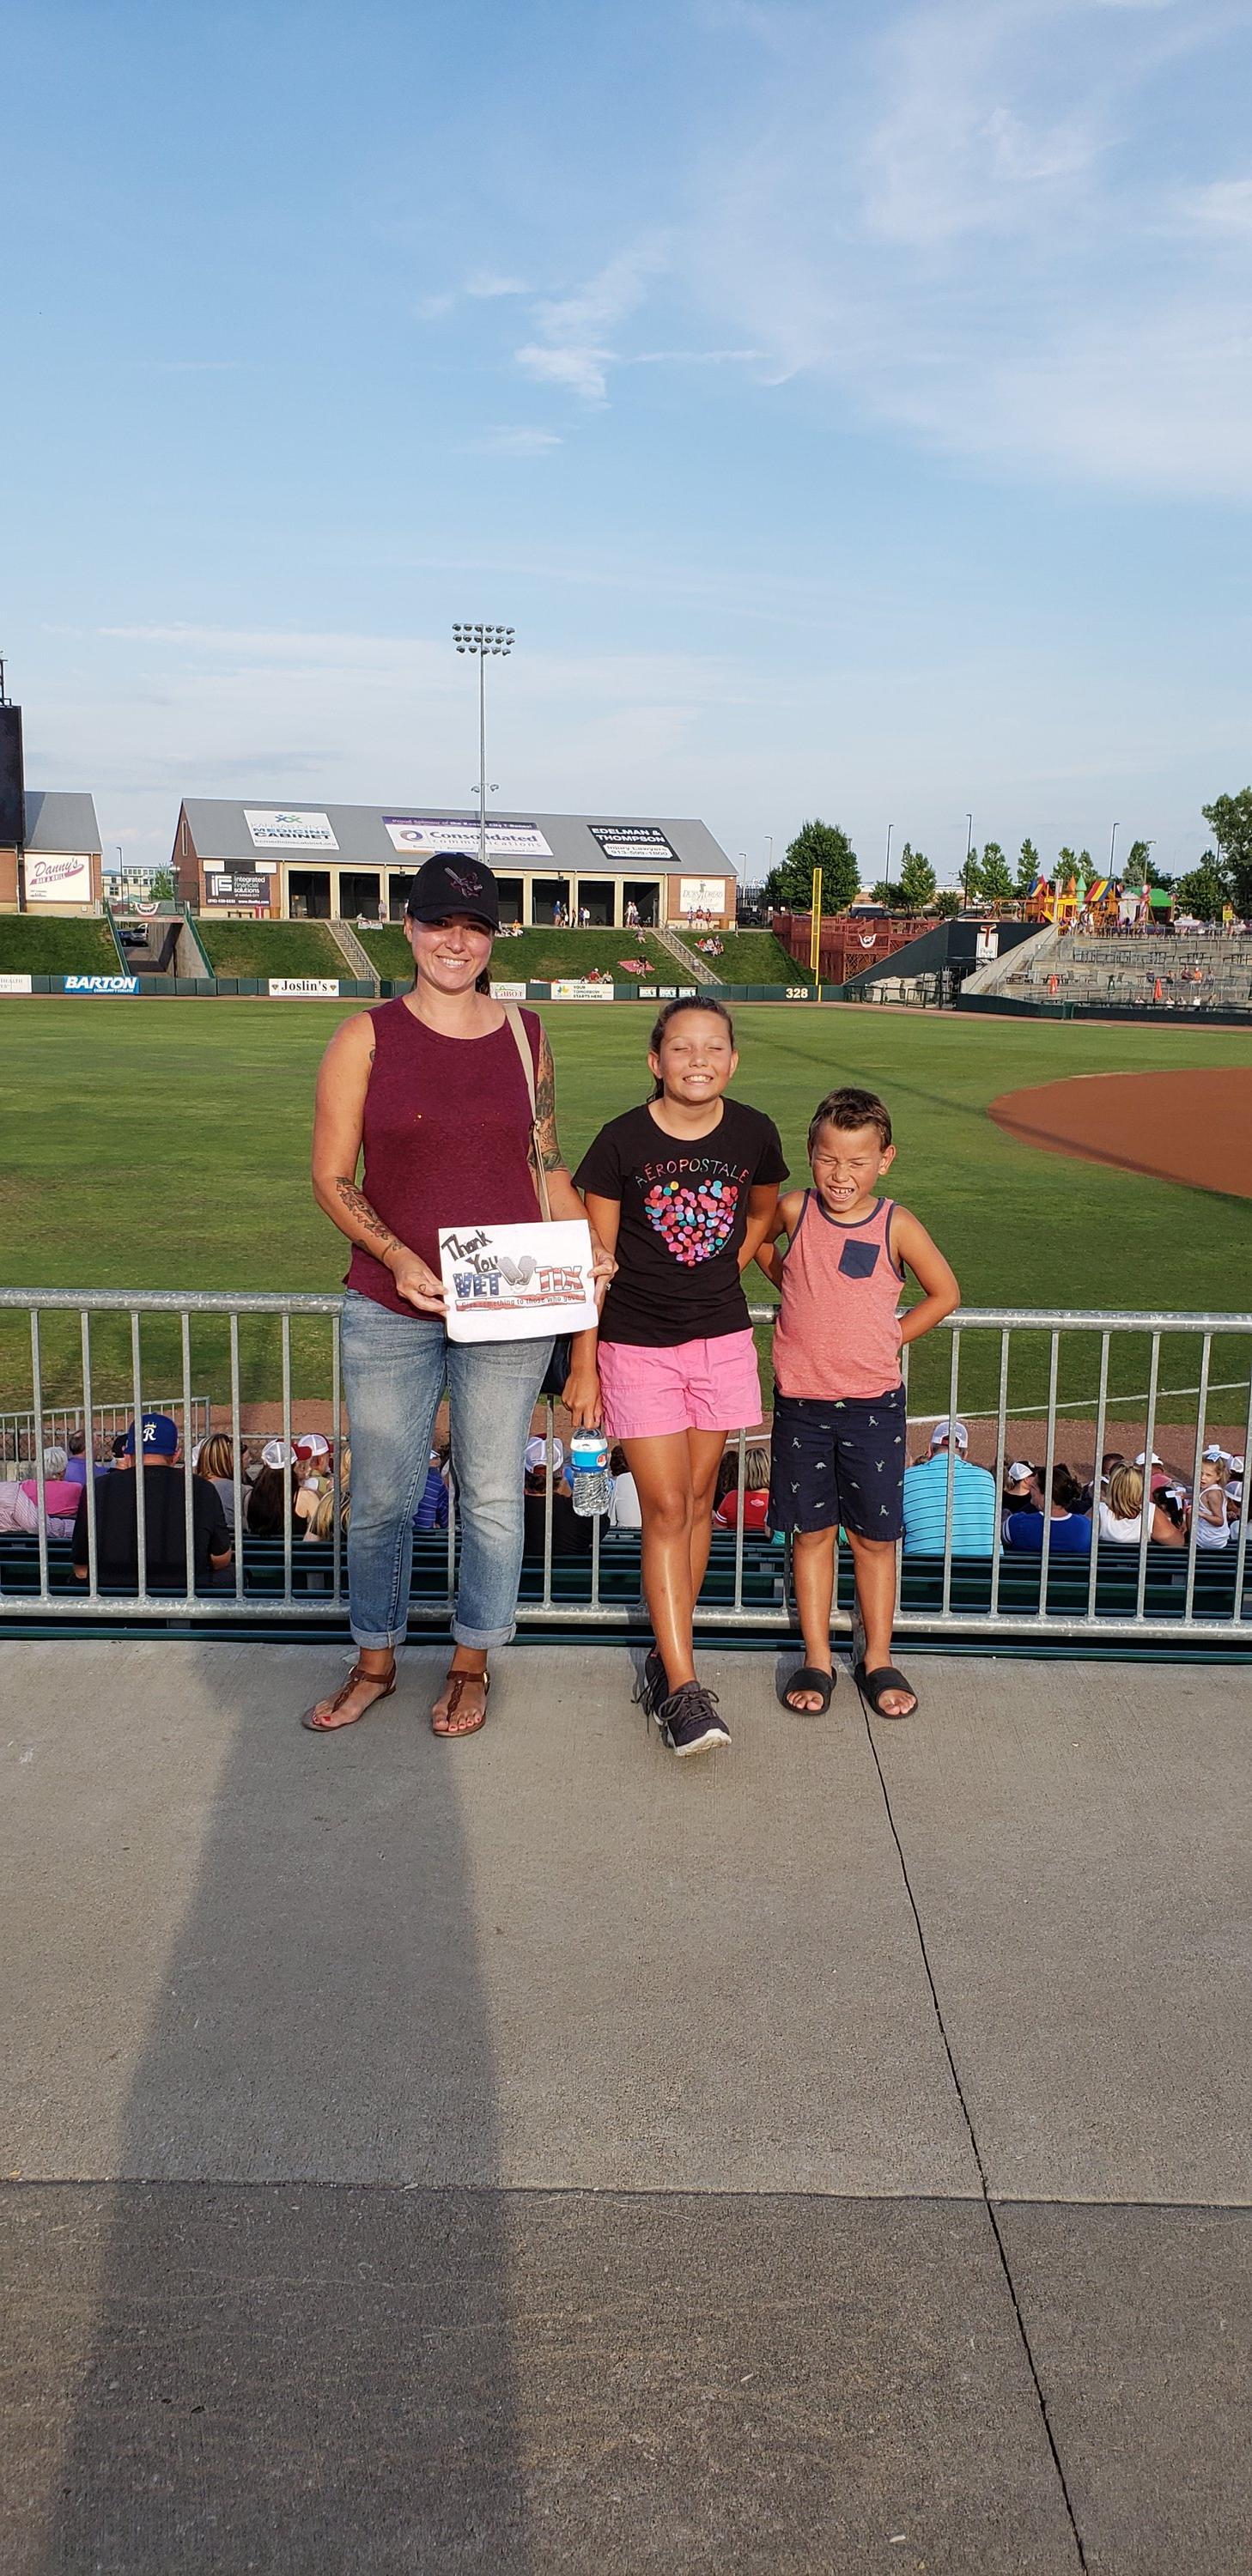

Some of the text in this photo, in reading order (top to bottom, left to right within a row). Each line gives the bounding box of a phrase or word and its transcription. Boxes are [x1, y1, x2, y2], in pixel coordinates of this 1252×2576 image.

[429, 831, 538, 842] Consoidated
[34, 857, 78, 878] Danny's
[65, 975, 137, 989] BARTON
[281, 980, 328, 992] Joslin's
[786, 987, 809, 999] 328
[635, 1158, 749, 1188] AÉROPOSTALE
[441, 1229, 494, 1261] Thank
[465, 1254, 500, 1275] You
[453, 1265, 584, 1298] VET TIX
[526, 1296, 545, 1305] those
[143, 1427, 156, 1442] R
